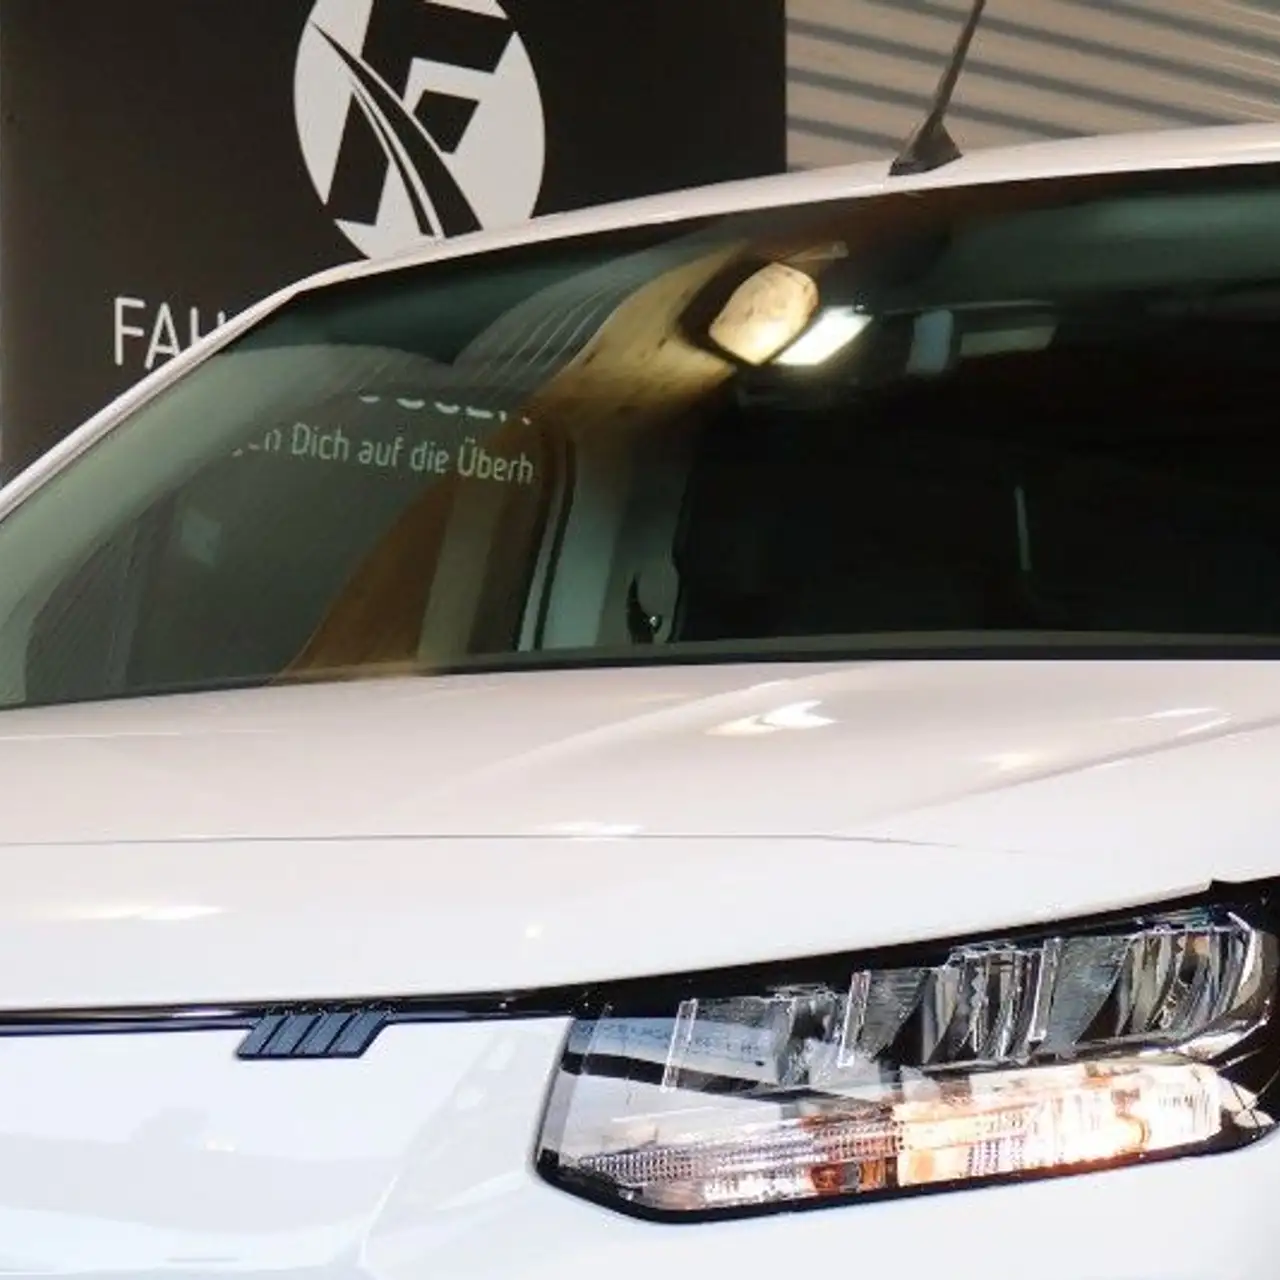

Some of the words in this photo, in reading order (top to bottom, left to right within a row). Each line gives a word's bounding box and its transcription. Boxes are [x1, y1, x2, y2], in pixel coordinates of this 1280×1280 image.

[291, 422, 350, 461] Dich
[357, 436, 404, 467] auf
[409, 441, 450, 474] die
